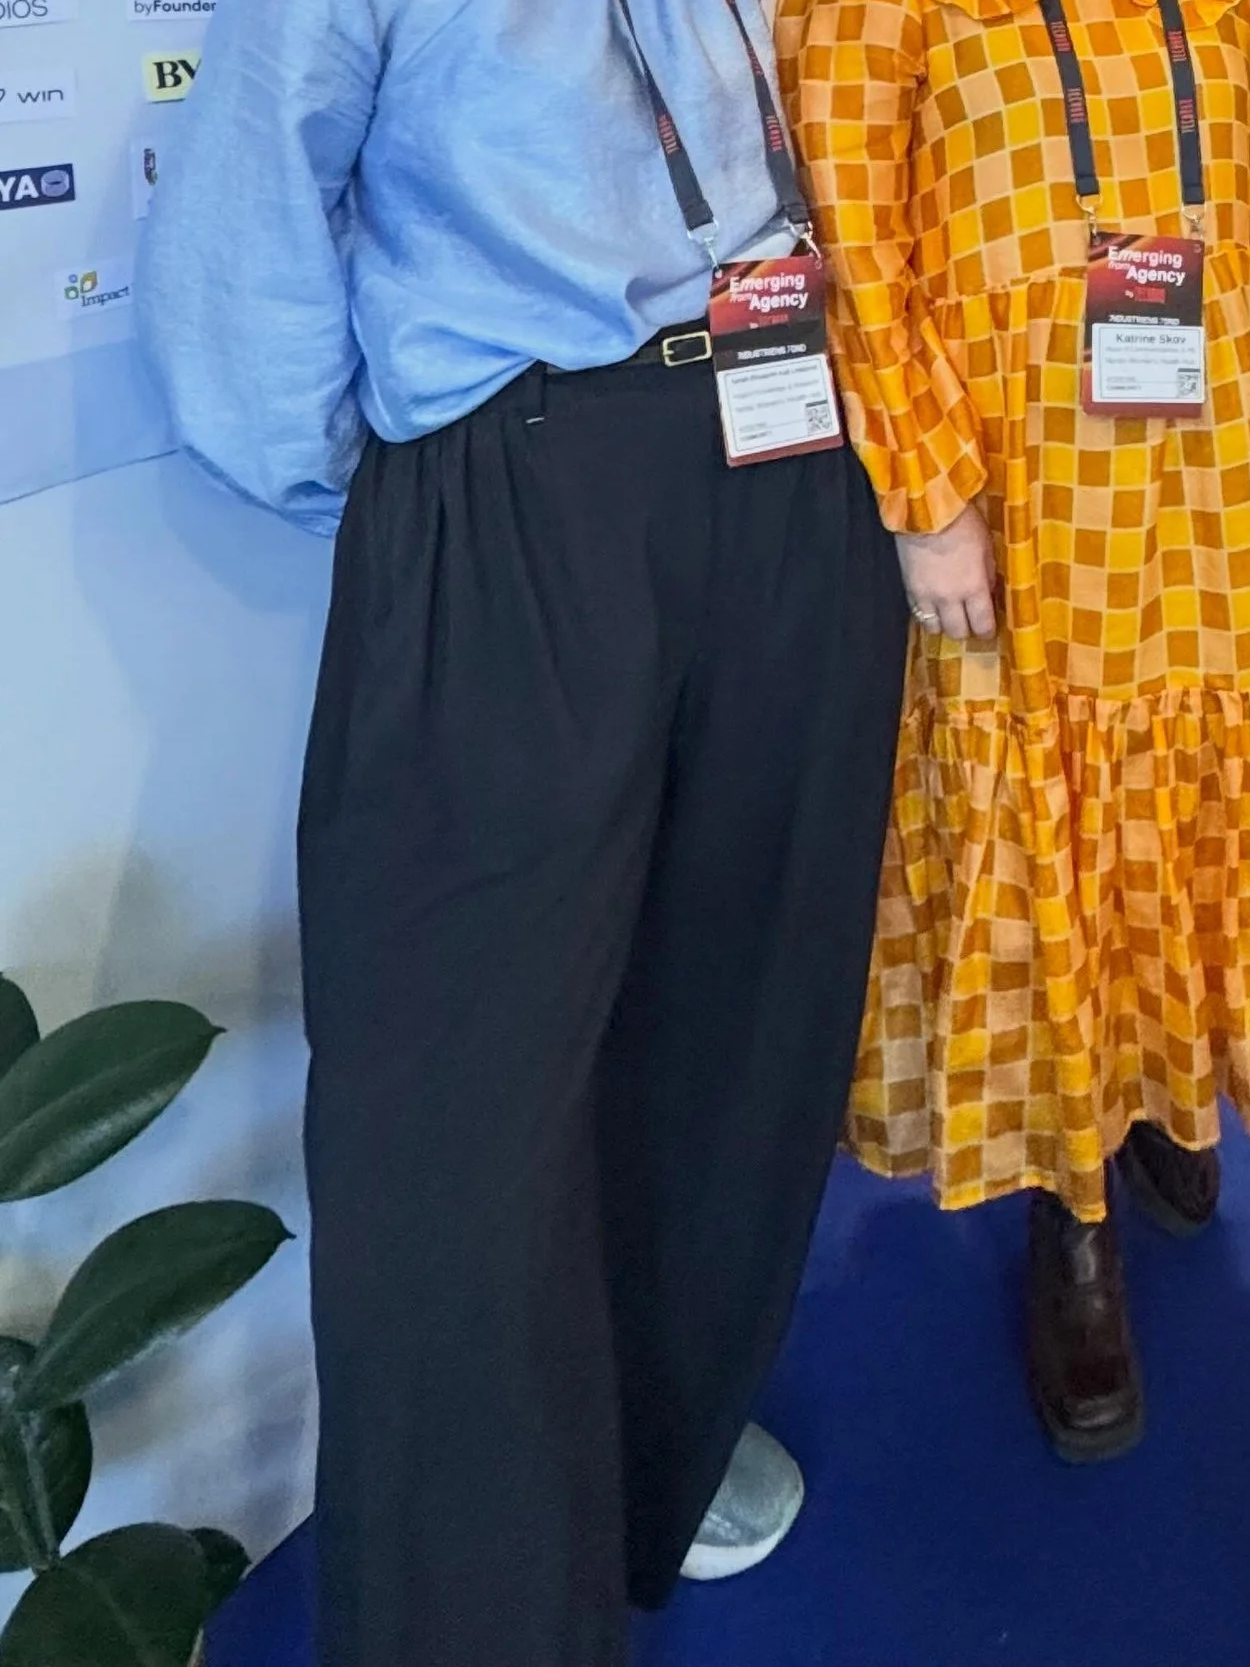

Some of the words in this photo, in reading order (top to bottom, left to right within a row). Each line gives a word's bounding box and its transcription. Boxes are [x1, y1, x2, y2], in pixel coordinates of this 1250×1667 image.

[1108, 245, 1182, 268] Emerging
[729, 272, 805, 293] Emerging
[1126, 266, 1185, 286] Agency
[749, 291, 809, 313] Agency
[1116, 333, 1156, 344] Katrine
[1159, 333, 1186, 344] Skov
